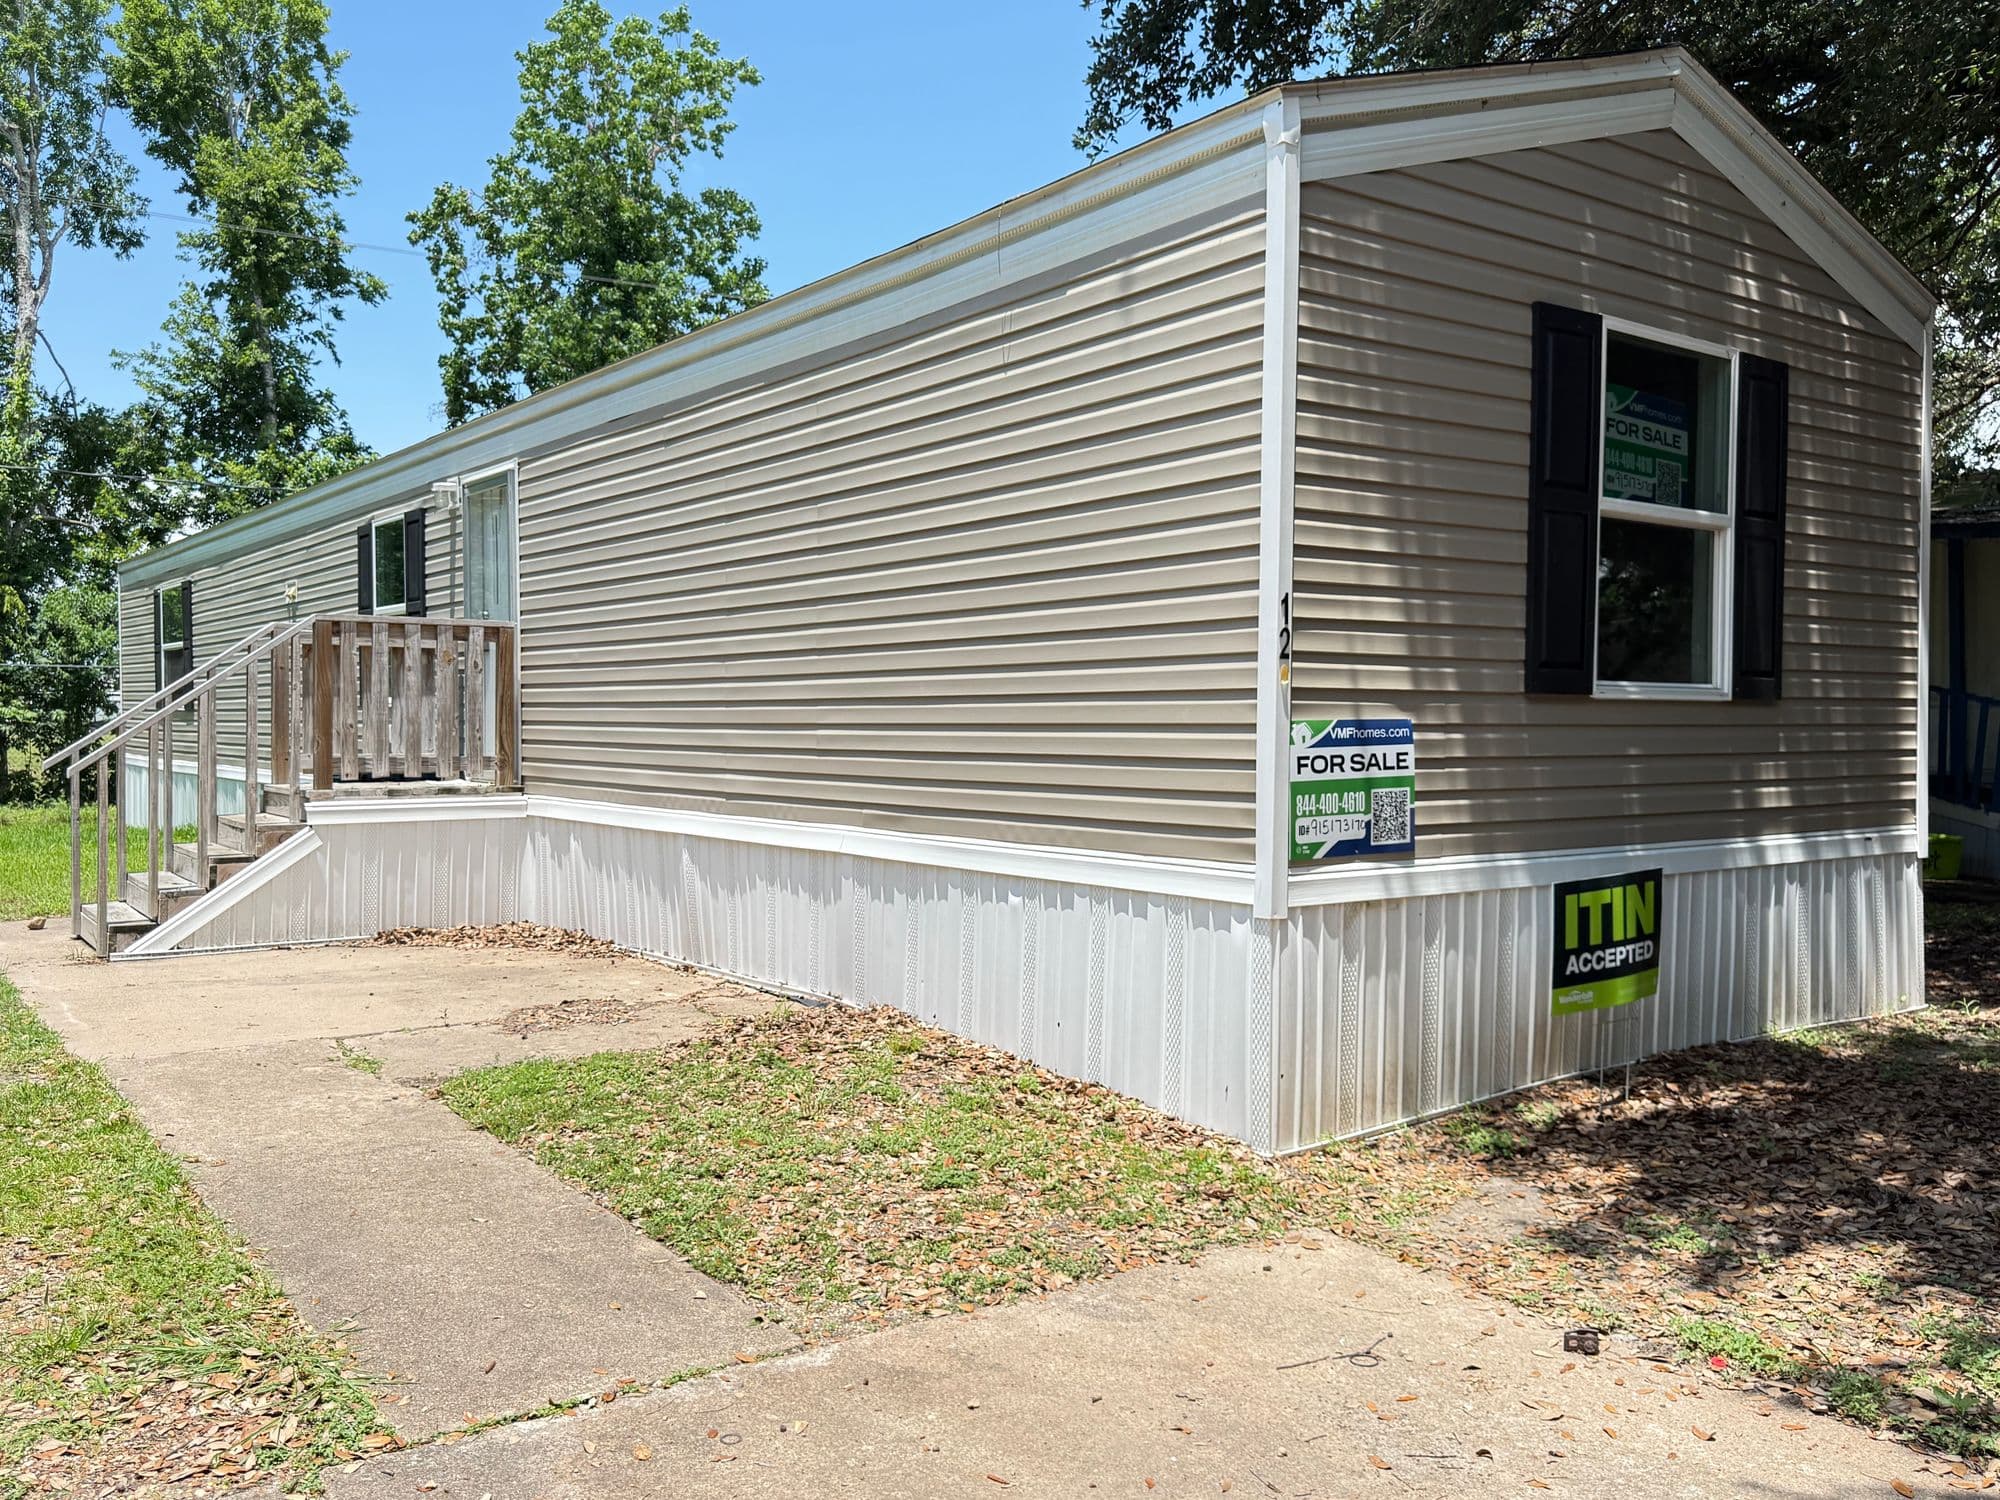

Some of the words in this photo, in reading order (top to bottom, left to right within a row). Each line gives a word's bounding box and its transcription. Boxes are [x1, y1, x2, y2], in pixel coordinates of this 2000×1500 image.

[1606, 418, 1640, 440] FOR
[1642, 426, 1682, 450] SALE
[1329, 727, 1410, 739] VMFhomes.com
[1297, 754, 1345, 775] FOR
[1350, 752, 1409, 772] SALE
[1296, 791, 1365, 816] 844-400-4610
[1565, 880, 1655, 950] ITIN
[1565, 940, 1654, 975] ACCEPTED
